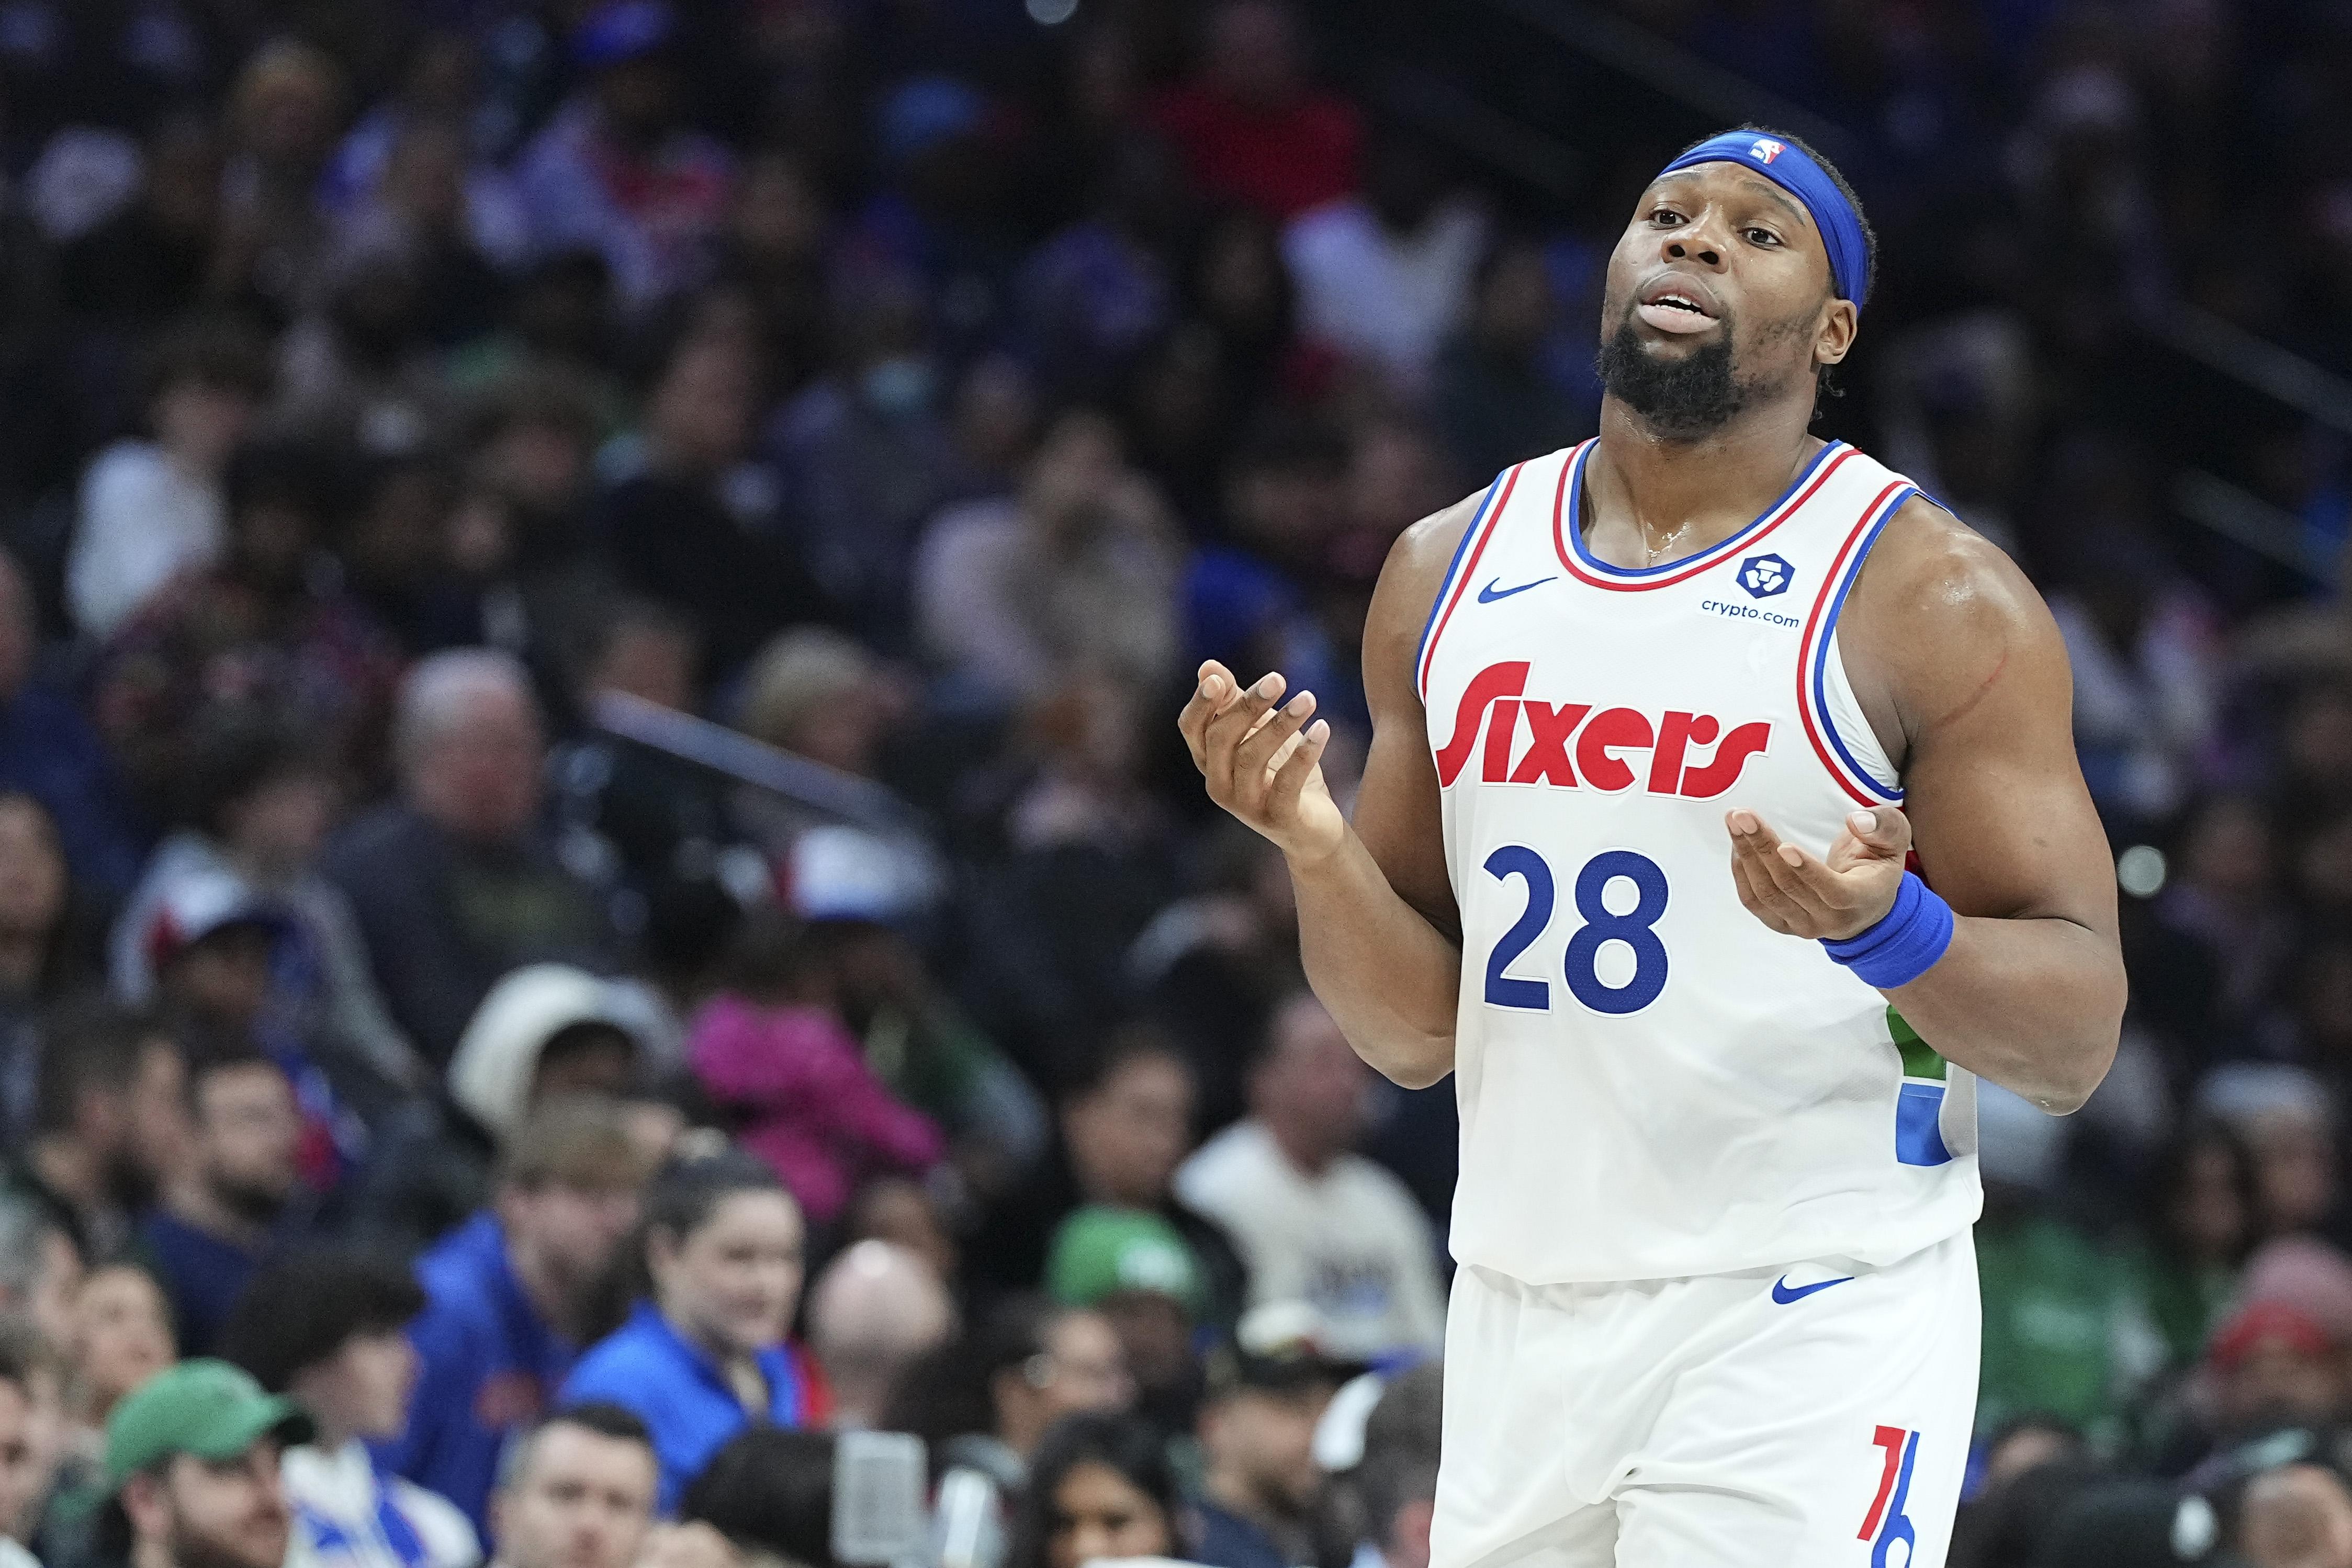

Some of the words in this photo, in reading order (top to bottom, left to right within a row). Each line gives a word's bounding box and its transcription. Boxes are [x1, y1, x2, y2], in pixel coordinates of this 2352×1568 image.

[1702, 600, 1799, 628] crypto.com
[1436, 661, 1772, 799] Sixers
[1483, 844, 1670, 1016] 28
[1857, 1425, 1921, 1568] 76
